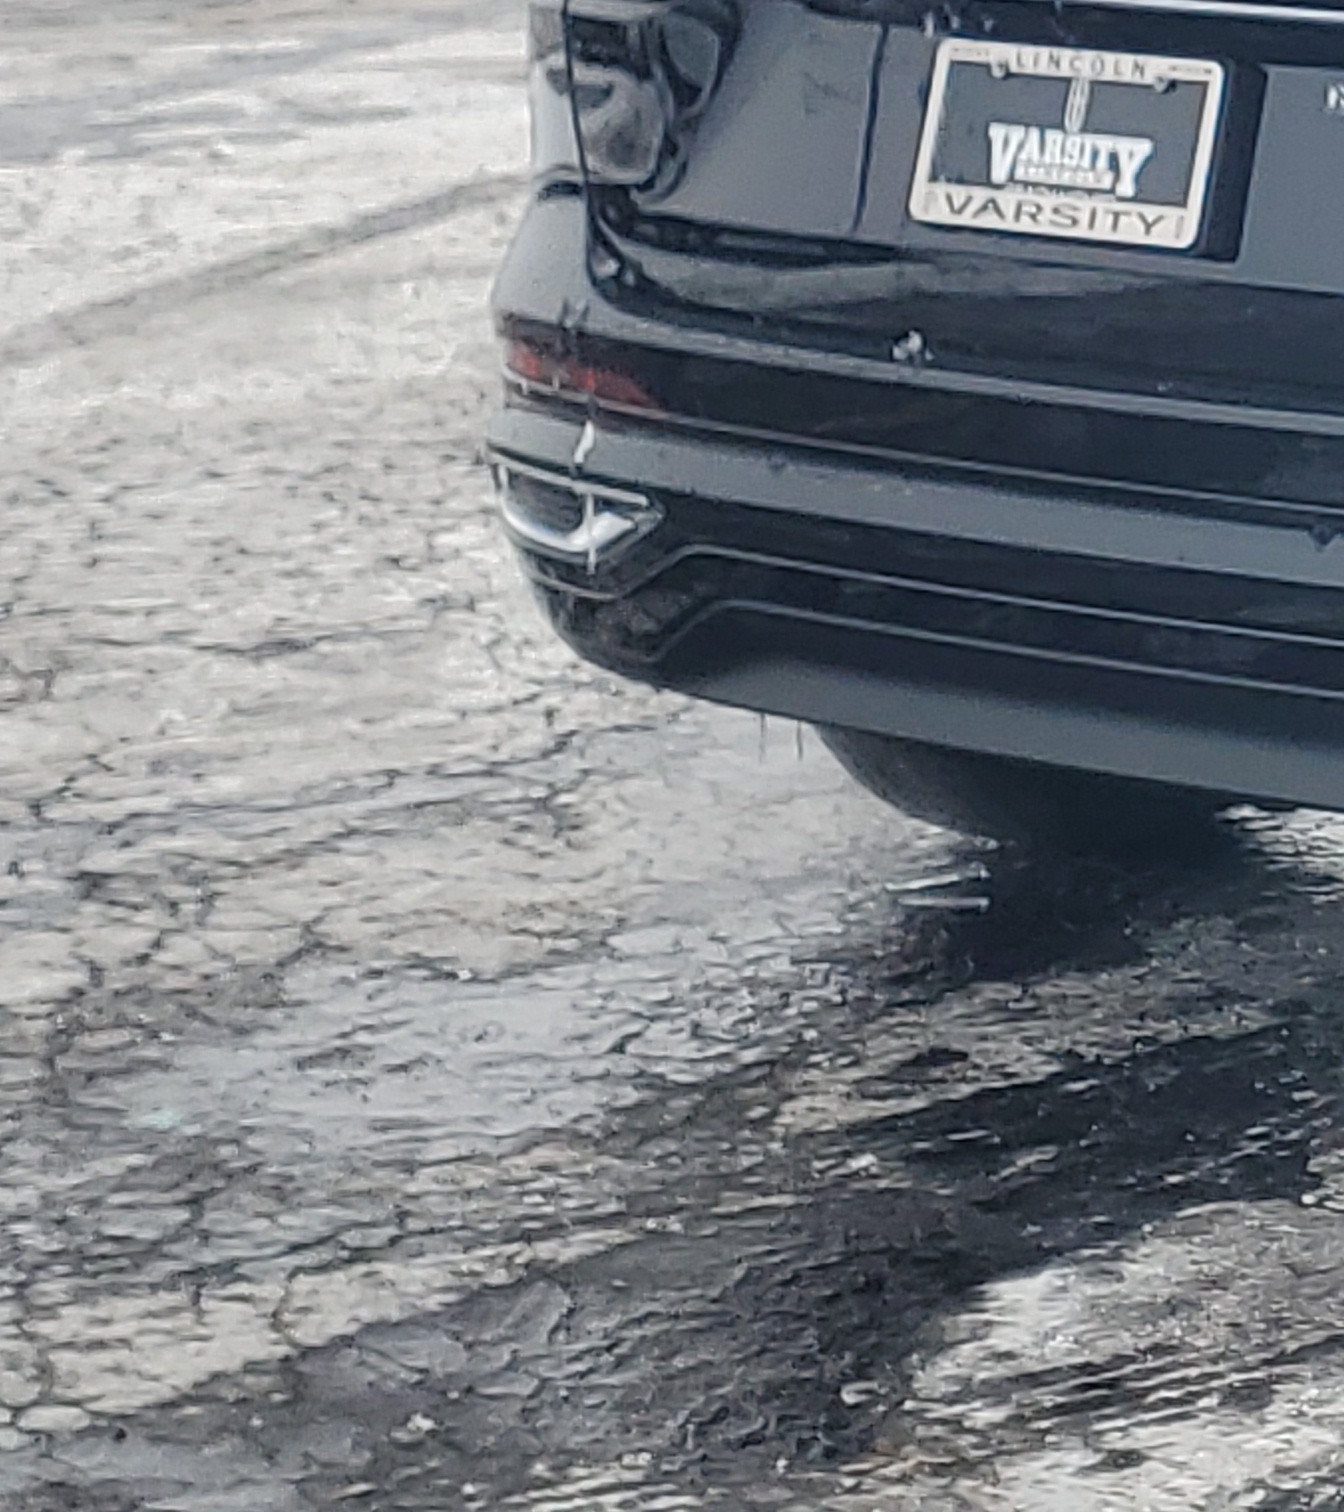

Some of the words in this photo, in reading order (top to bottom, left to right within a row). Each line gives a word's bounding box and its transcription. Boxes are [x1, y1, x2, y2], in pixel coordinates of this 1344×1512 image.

[1014, 51, 1147, 79] LINCOLN
[987, 121, 1155, 198] VARSITY
[943, 191, 1166, 236] VARSITY
